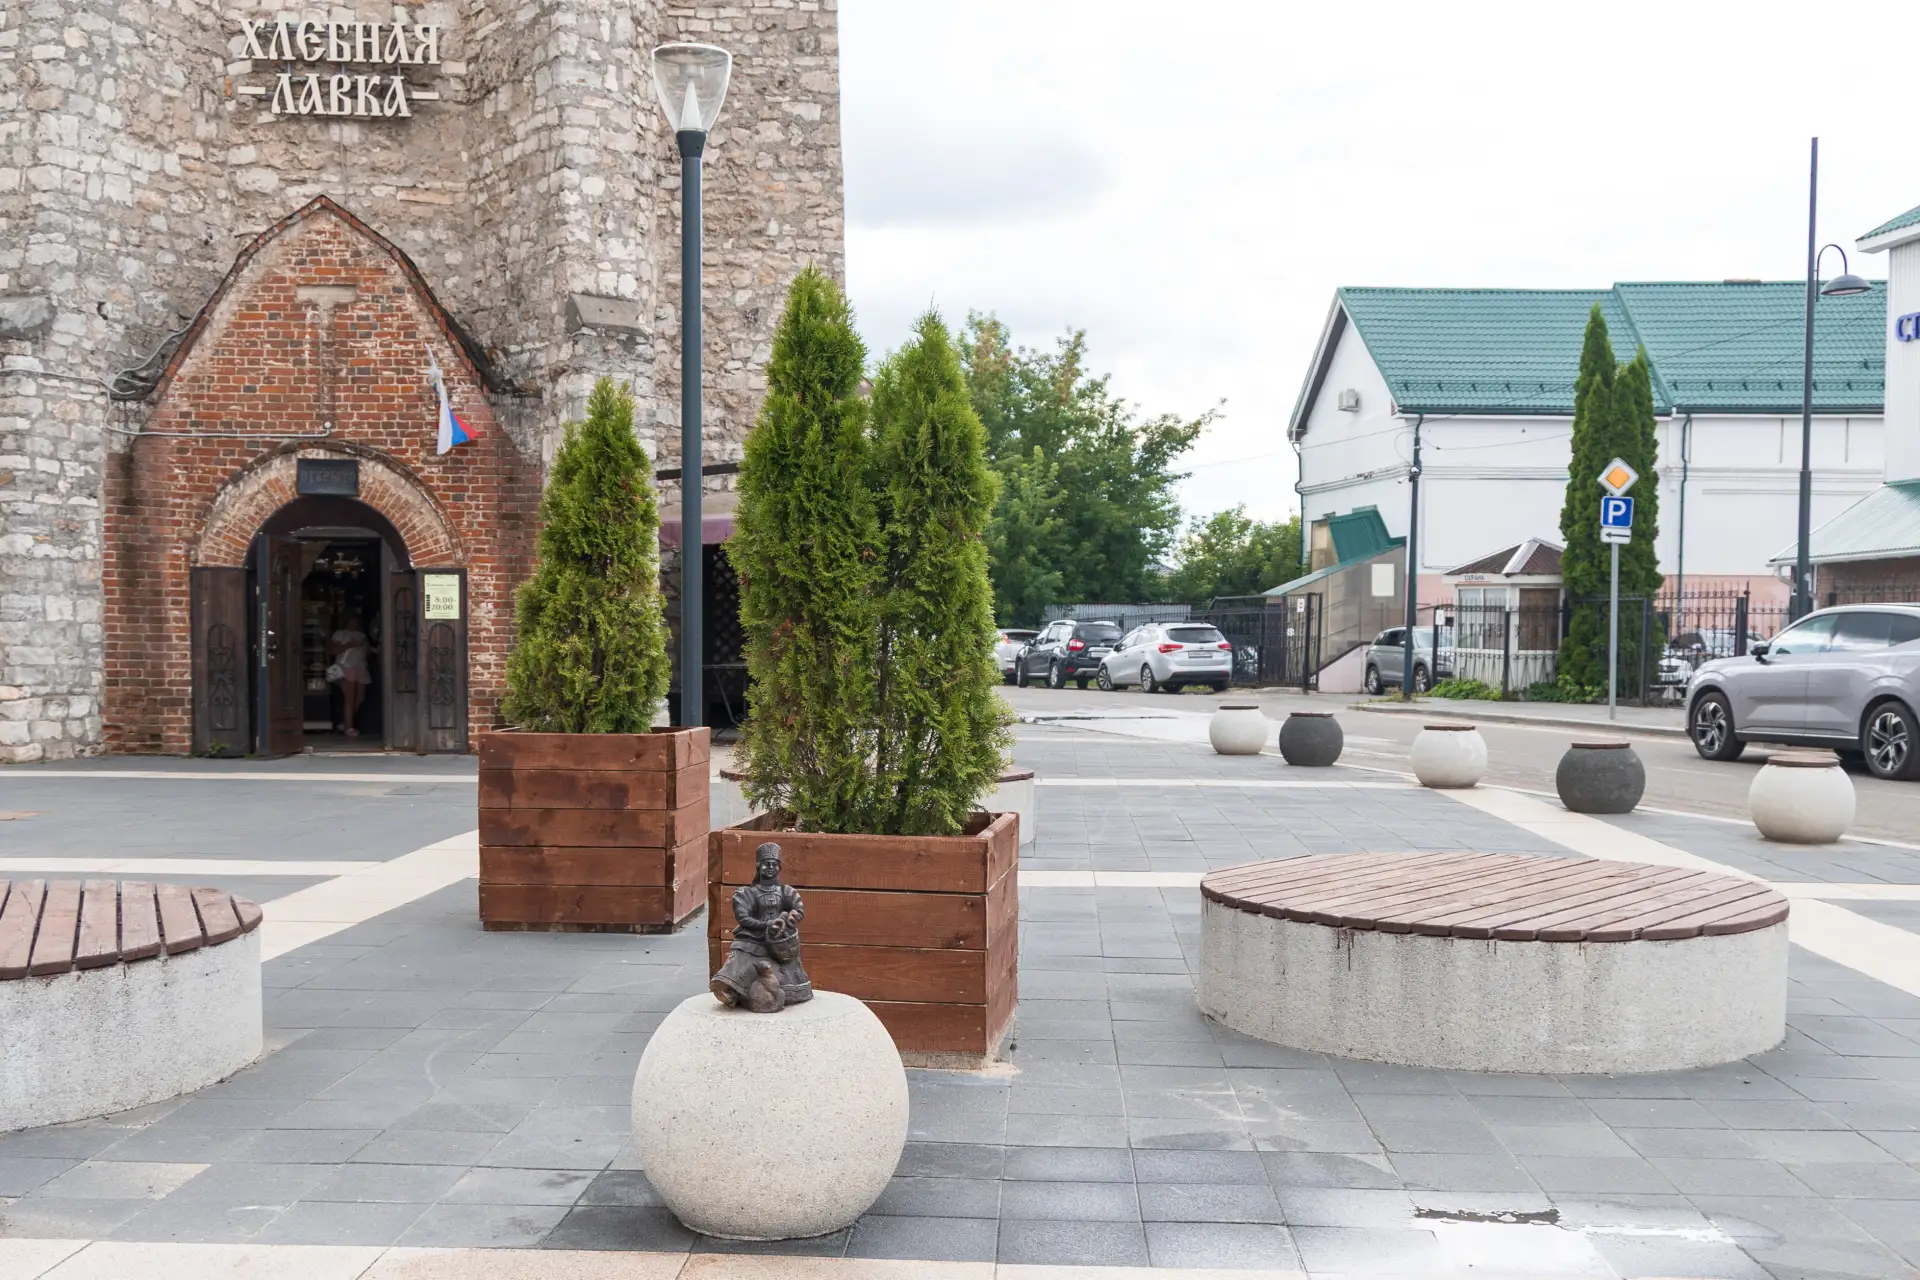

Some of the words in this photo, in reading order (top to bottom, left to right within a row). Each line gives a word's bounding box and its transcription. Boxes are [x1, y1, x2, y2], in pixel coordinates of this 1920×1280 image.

[238, 19, 441, 65] ХЛЕБНАЯ
[271, 73, 412, 118] ЛАВКА
[1608, 500, 1626, 524] P
